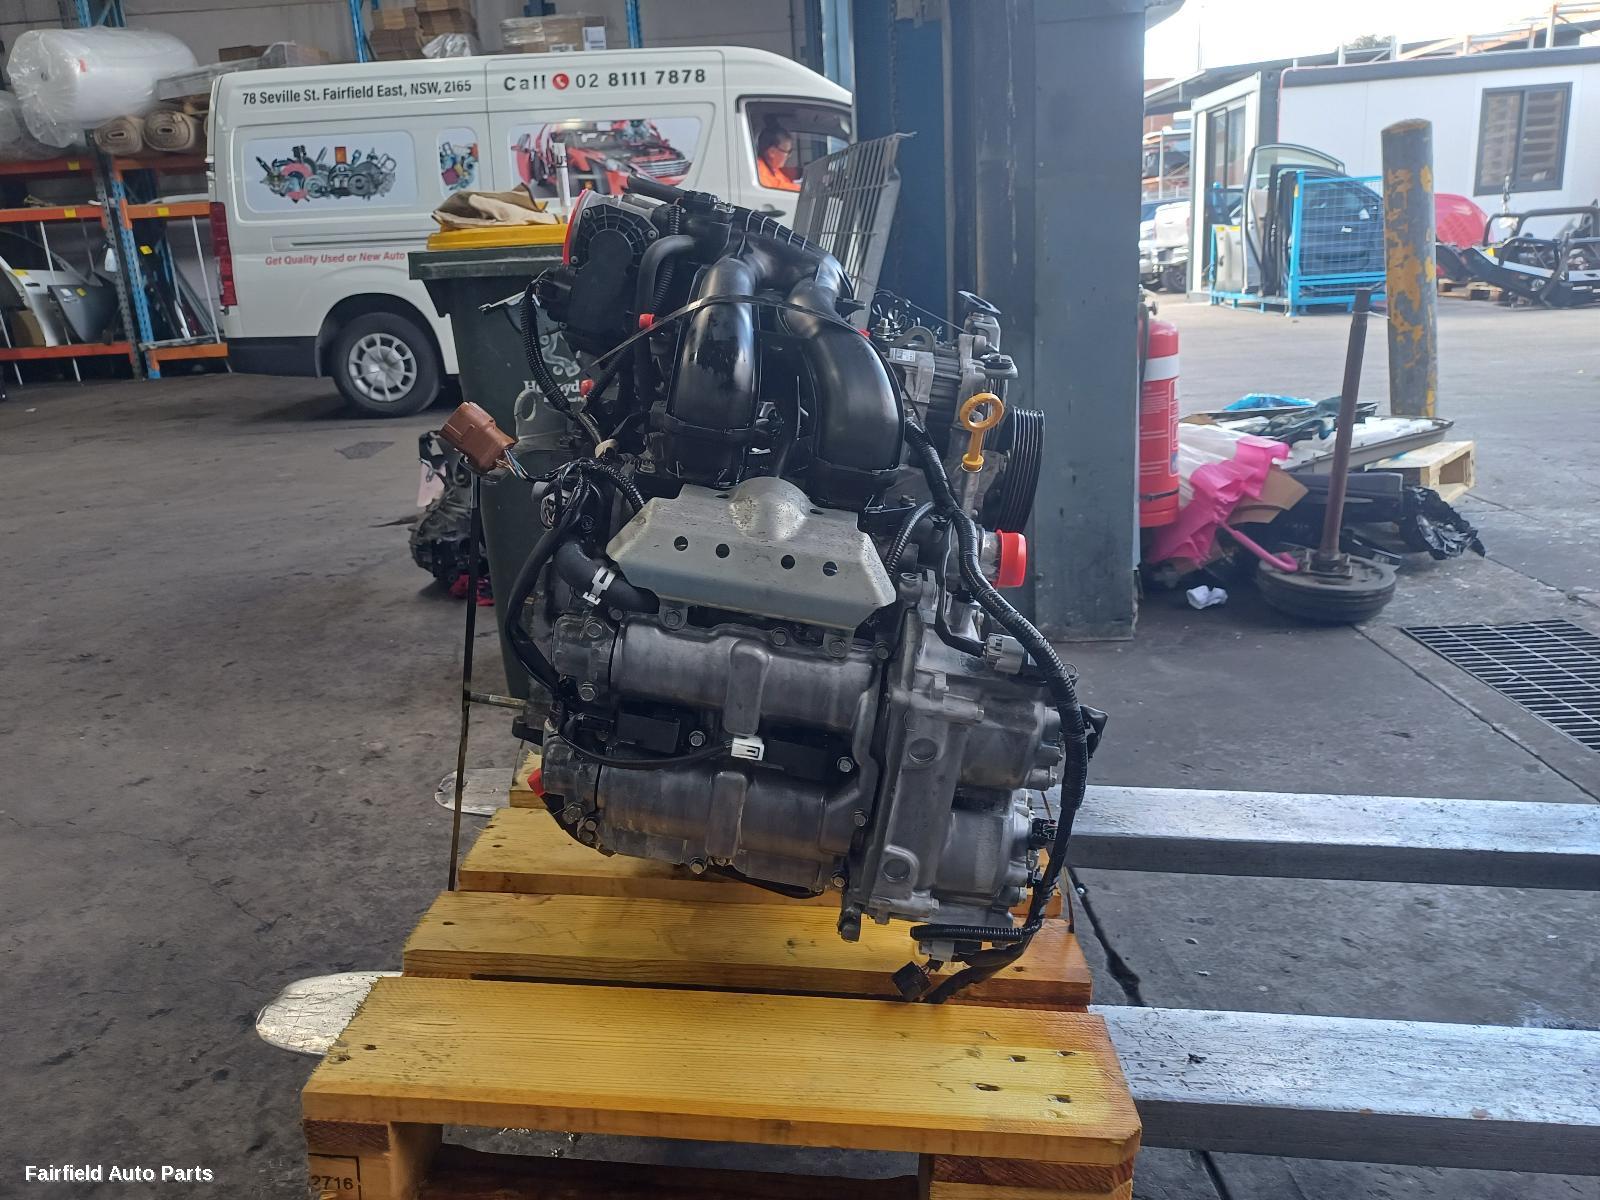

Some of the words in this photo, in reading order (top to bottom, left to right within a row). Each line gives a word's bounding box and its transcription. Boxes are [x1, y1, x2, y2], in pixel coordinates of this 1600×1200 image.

[503, 74, 546, 91] Call
[575, 73, 599, 88] 02
[608, 71, 646, 87] 8111
[655, 69, 706, 84] 7878
[242, 92, 256, 105] 78
[259, 90, 300, 104] Seville
[303, 88, 320, 101] St.
[323, 85, 374, 101] Fairfield
[377, 84, 407, 97] East,
[410, 82, 441, 95] NSW,
[444, 80, 472, 93] 2165
[265, 256, 282, 266] Get
[284, 254, 318, 266] Quality
[320, 253, 345, 264] Used
[346, 254, 357, 263] or
[359, 252, 382, 262] New
[383, 251, 406, 261] Auto
